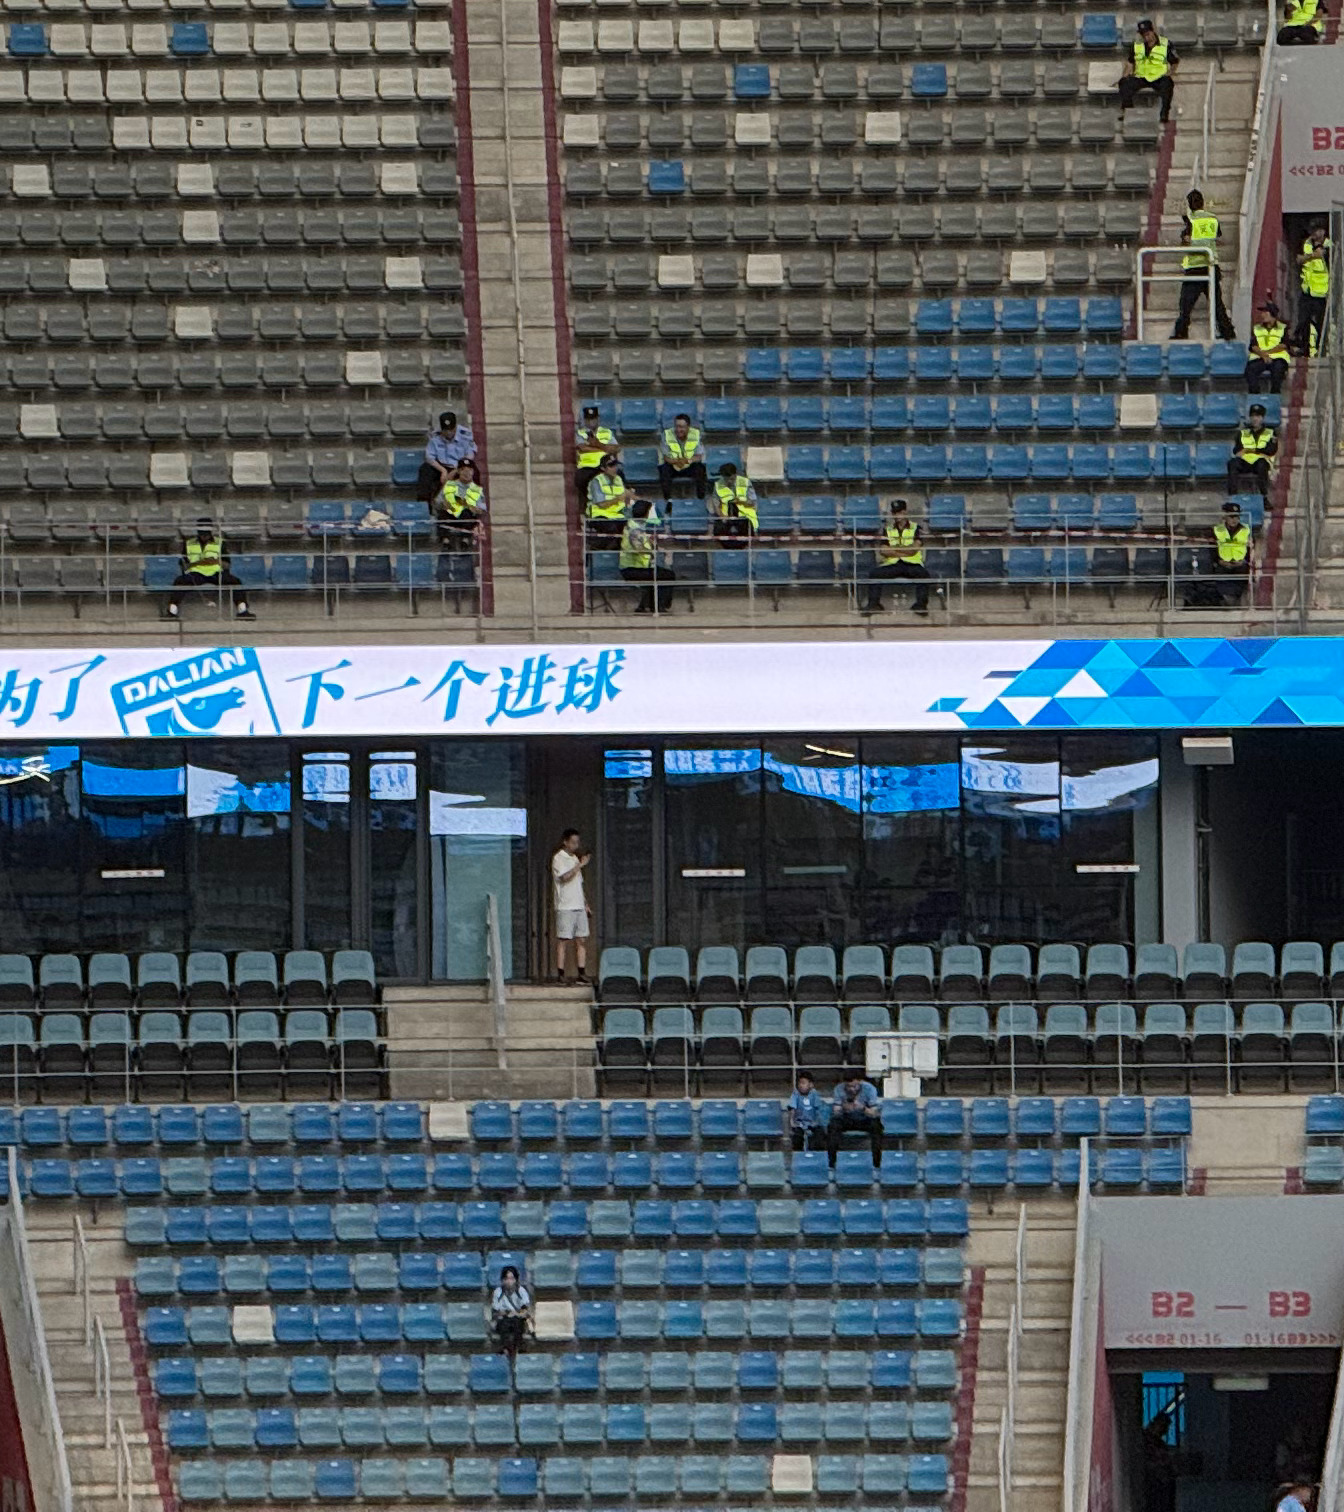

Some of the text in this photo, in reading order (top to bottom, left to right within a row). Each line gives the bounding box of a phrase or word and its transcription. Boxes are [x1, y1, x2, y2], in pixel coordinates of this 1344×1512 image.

[121, 647, 247, 705] DALIAN
[286, 648, 628, 728] 下一个进球
[1151, 1291, 1195, 1318] B2
[1268, 1291, 1311, 1318] B3
